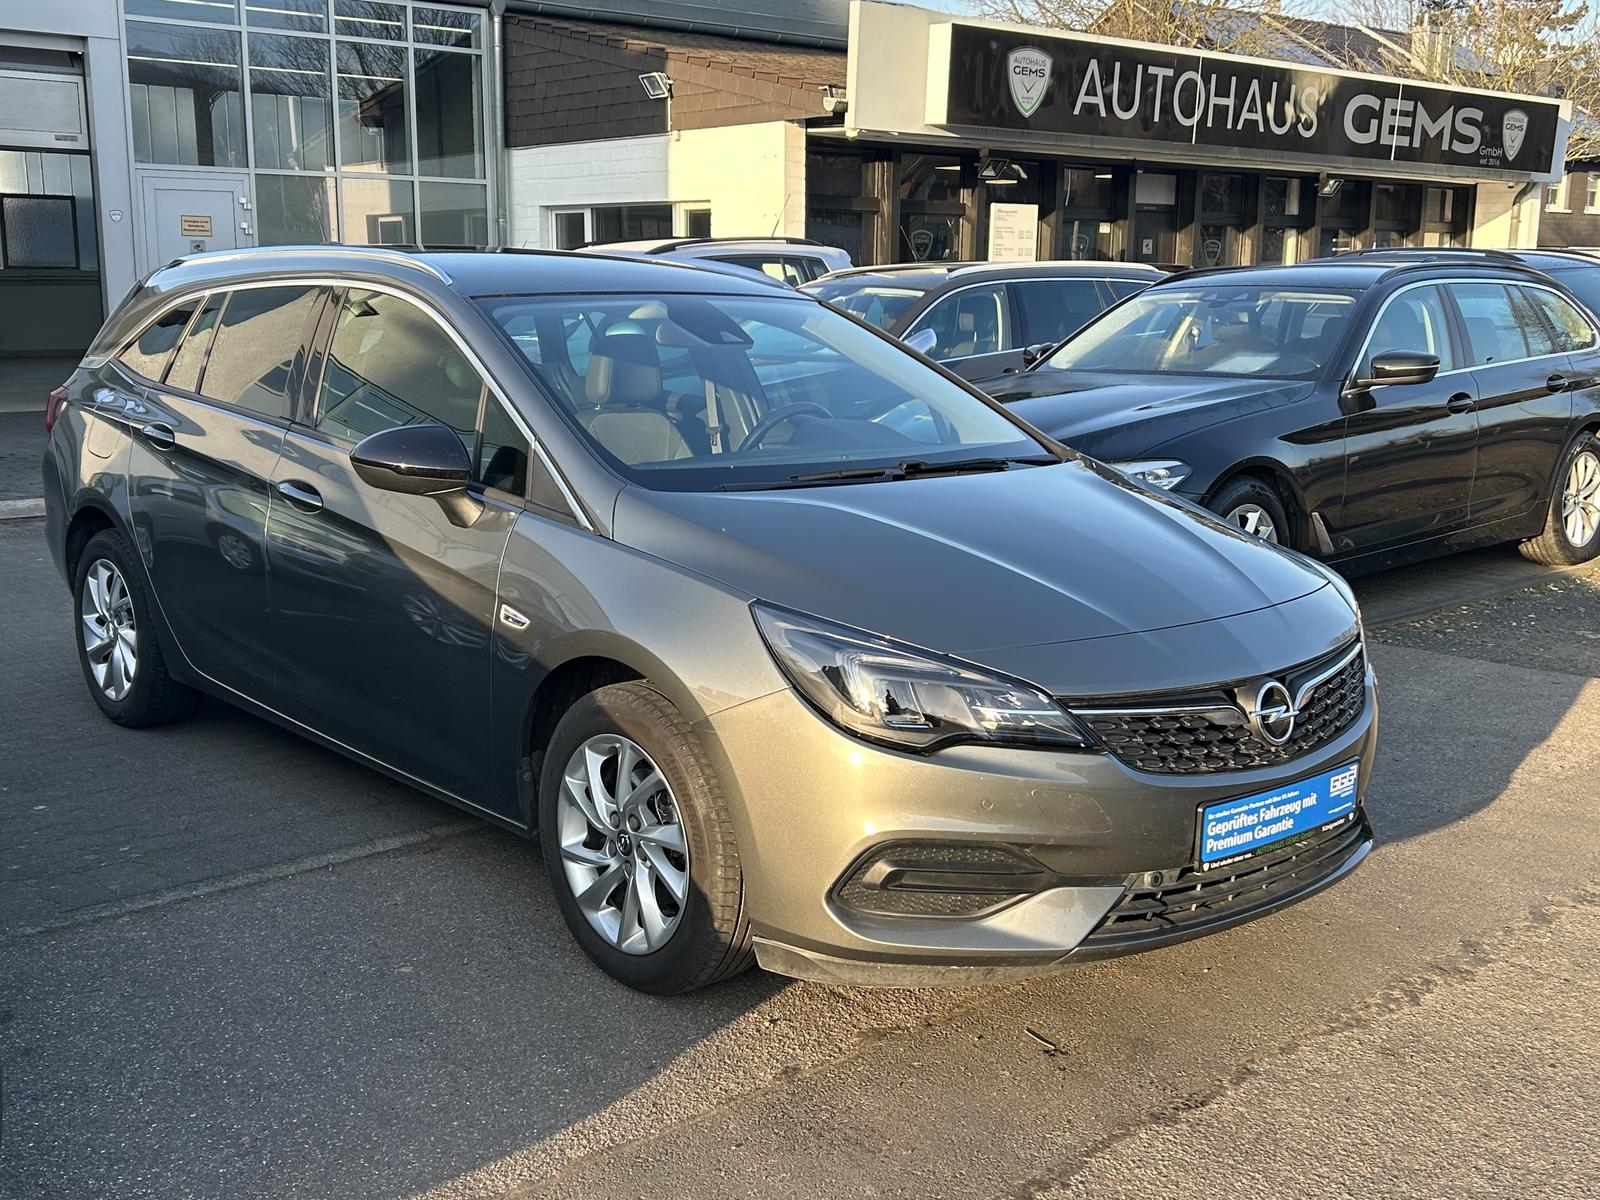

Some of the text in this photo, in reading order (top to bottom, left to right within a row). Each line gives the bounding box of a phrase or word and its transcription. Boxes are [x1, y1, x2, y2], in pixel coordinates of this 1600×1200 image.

[1013, 65, 1046, 78] GEMS
[1014, 56, 1047, 67] AUTOHAUS
[1073, 58, 1484, 154] AUTOHAUS GEMS
[1505, 123, 1525, 131] GEMS
[1480, 145, 1503, 157] GmbH
[1207, 813, 1259, 836] Geprüftes
[1260, 799, 1302, 821] Fahrzeug
[1302, 792, 1318, 807] mit
[1206, 816, 1295, 853] Premium Garantie
[1256, 840, 1285, 856] AUTOHAUS
[1301, 829, 1316, 840] GmbH
